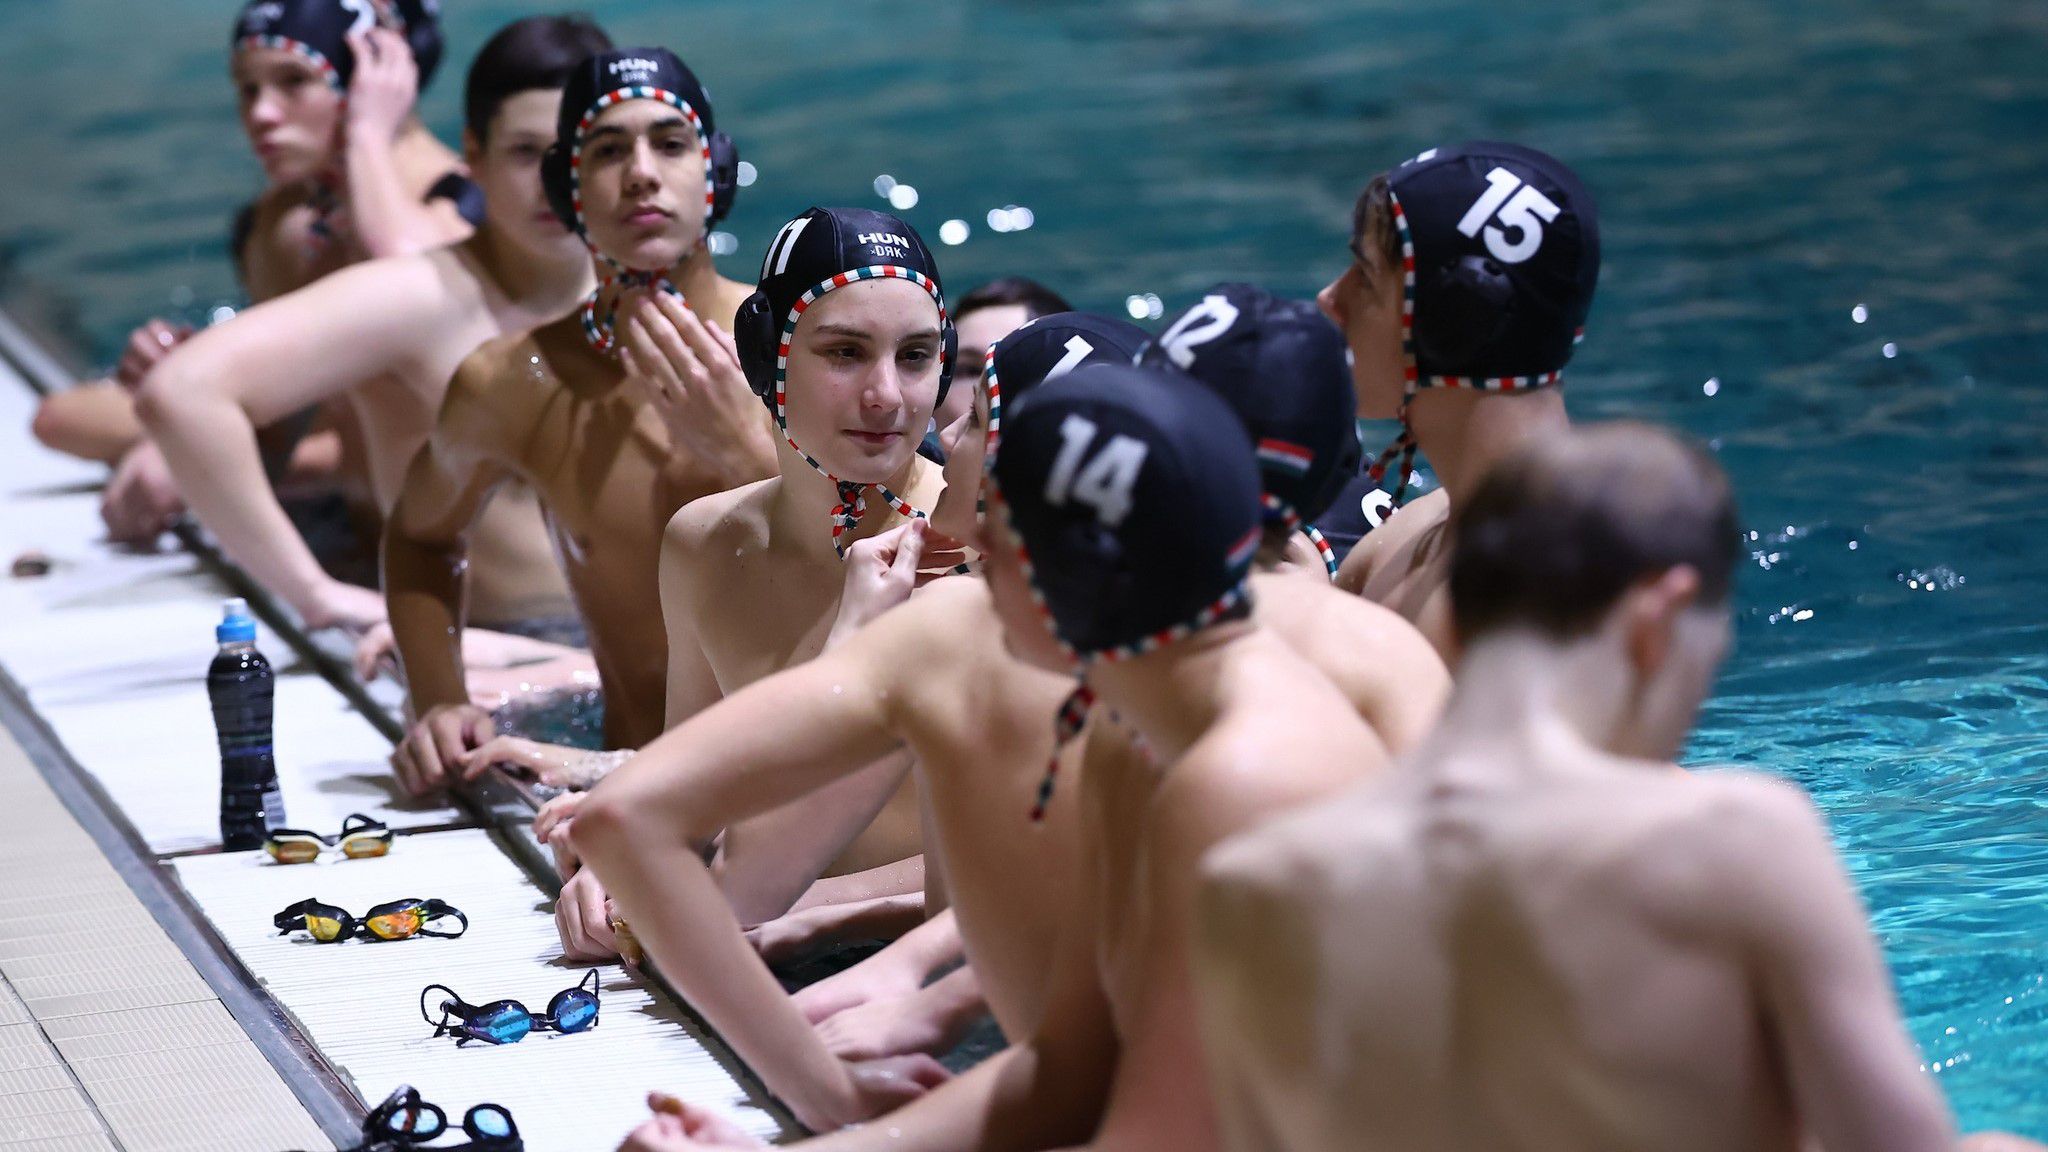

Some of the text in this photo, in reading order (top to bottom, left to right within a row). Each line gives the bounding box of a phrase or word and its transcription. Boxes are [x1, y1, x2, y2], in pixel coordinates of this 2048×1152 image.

[608, 58, 659, 75] HUN
[857, 232, 910, 249] HUN
[1456, 166, 1561, 264] 15
[762, 216, 813, 280] 11
[1043, 412, 1149, 527] 14
